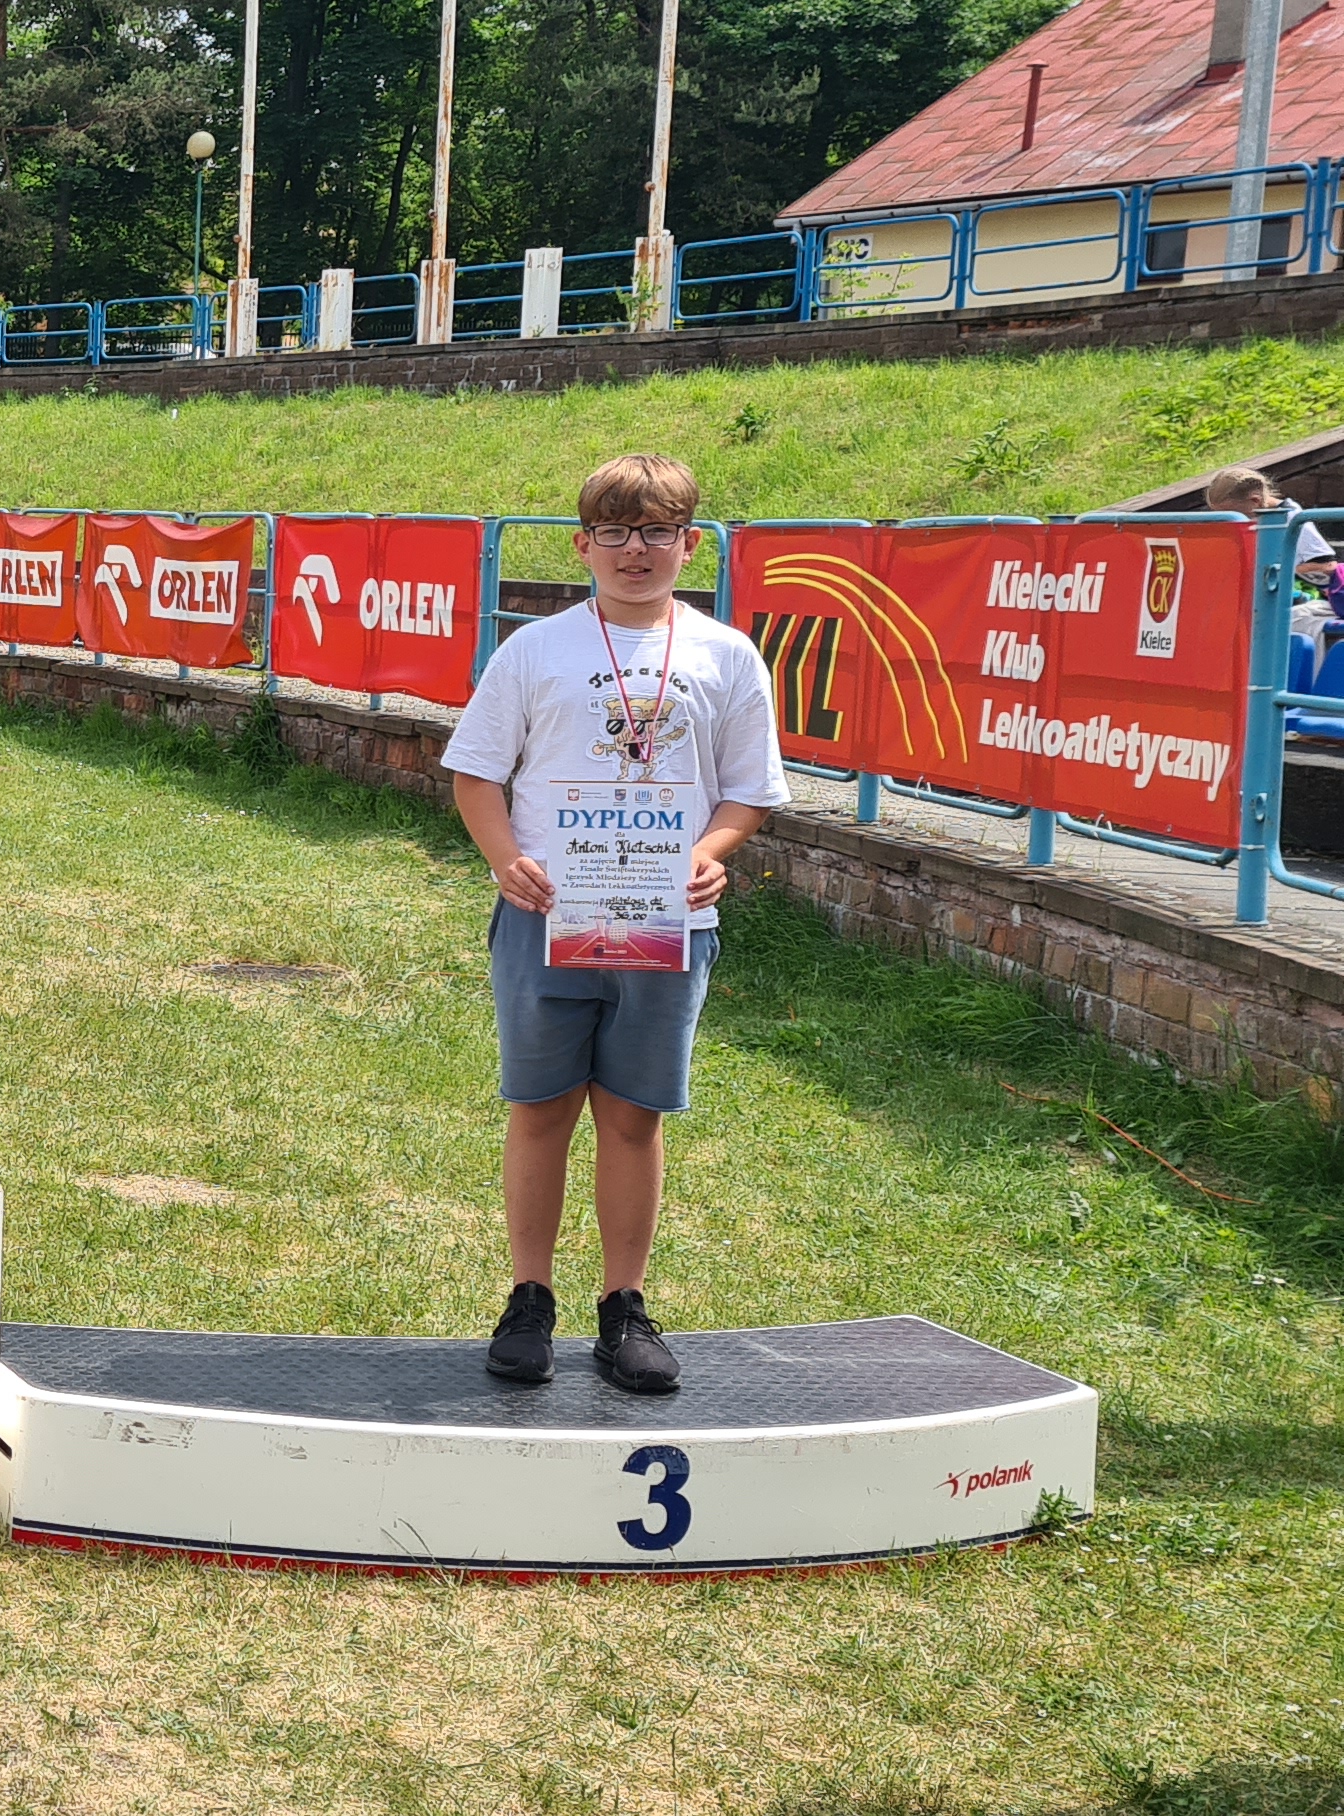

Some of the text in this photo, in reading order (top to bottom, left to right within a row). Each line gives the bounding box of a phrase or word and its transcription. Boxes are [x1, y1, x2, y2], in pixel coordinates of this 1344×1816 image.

[157, 569, 233, 614] ORLEN
[359, 577, 456, 638] ORLEN
[986, 560, 1108, 613] Kielecki
[1149, 575, 1174, 613] CK
[981, 629, 1045, 683] Klub
[1139, 630, 1172, 651] Kielce
[978, 698, 1231, 802] Lekkoatletyczny
[556, 808, 685, 831] DYPLOM
[565, 837, 609, 856] Antoni
[617, 1444, 693, 1551] 3
[964, 1458, 1034, 1499] polanik
